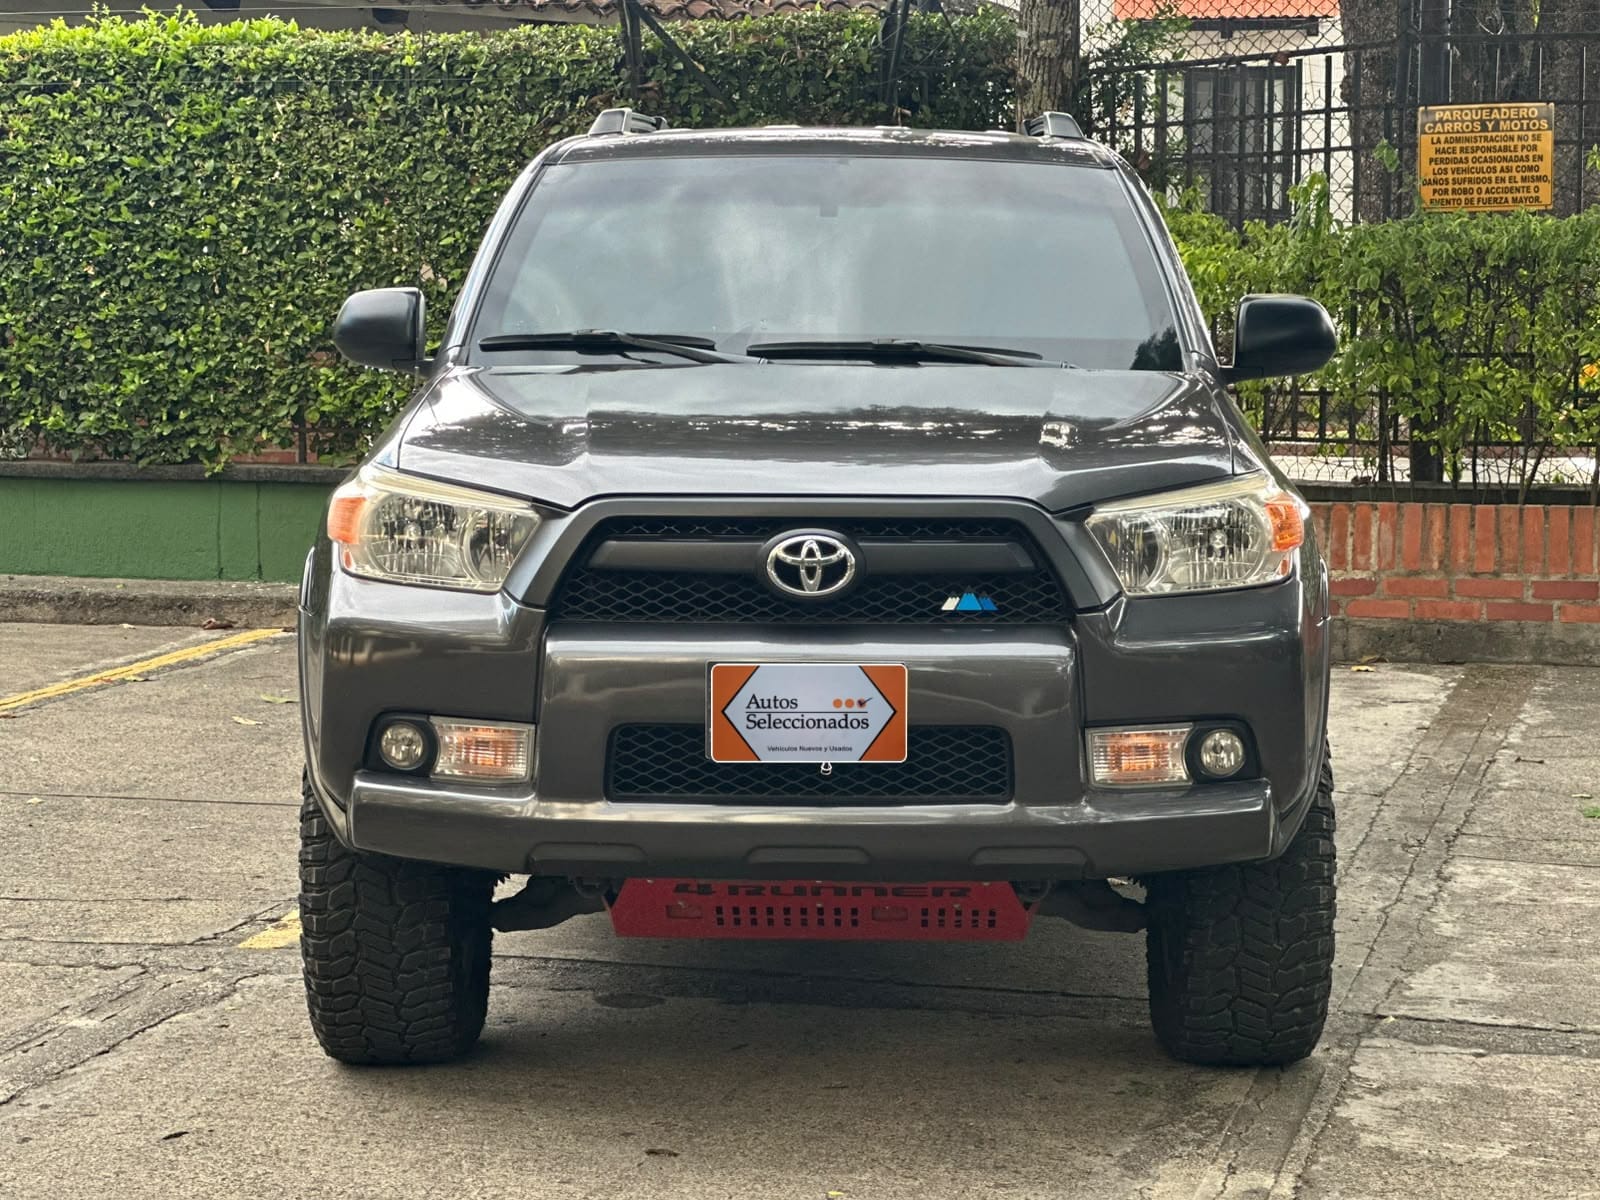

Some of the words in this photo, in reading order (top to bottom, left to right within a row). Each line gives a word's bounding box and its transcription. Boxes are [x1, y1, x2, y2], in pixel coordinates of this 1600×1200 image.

[1435, 107, 1538, 121] PARQUEADERO
[1424, 121, 1481, 133] CARROS
[1485, 120, 1495, 131] Y
[1499, 119, 1549, 131] MOTOS
[1431, 136, 1441, 145] LA
[1517, 134, 1529, 142] NO
[1531, 133, 1542, 142] SE
[1434, 146, 1457, 155] HACE
[1459, 144, 1519, 154] RESPONSABLE
[1520, 144, 1538, 152] POR
[1471, 154, 1530, 165] OCASIONADAS
[1532, 154, 1544, 162] EN
[1432, 167, 1449, 176] LOS
[1515, 164, 1540, 173] COMO
[1451, 175, 1493, 186] SUFRIDOS
[1495, 175, 1506, 184] EN
[1508, 175, 1519, 184] EL
[1520, 174, 1551, 184] MISMO,
[1432, 187, 1450, 197] POR
[1451, 186, 1474, 197] ROBO
[1476, 186, 1483, 196] O
[1484, 185, 1531, 195] ACCIDENTE
[1533, 185, 1540, 194] O
[1464, 197, 1475, 206] DE
[1476, 196, 1509, 206] FUERZA
[1511, 195, 1543, 204] MAYOR.
